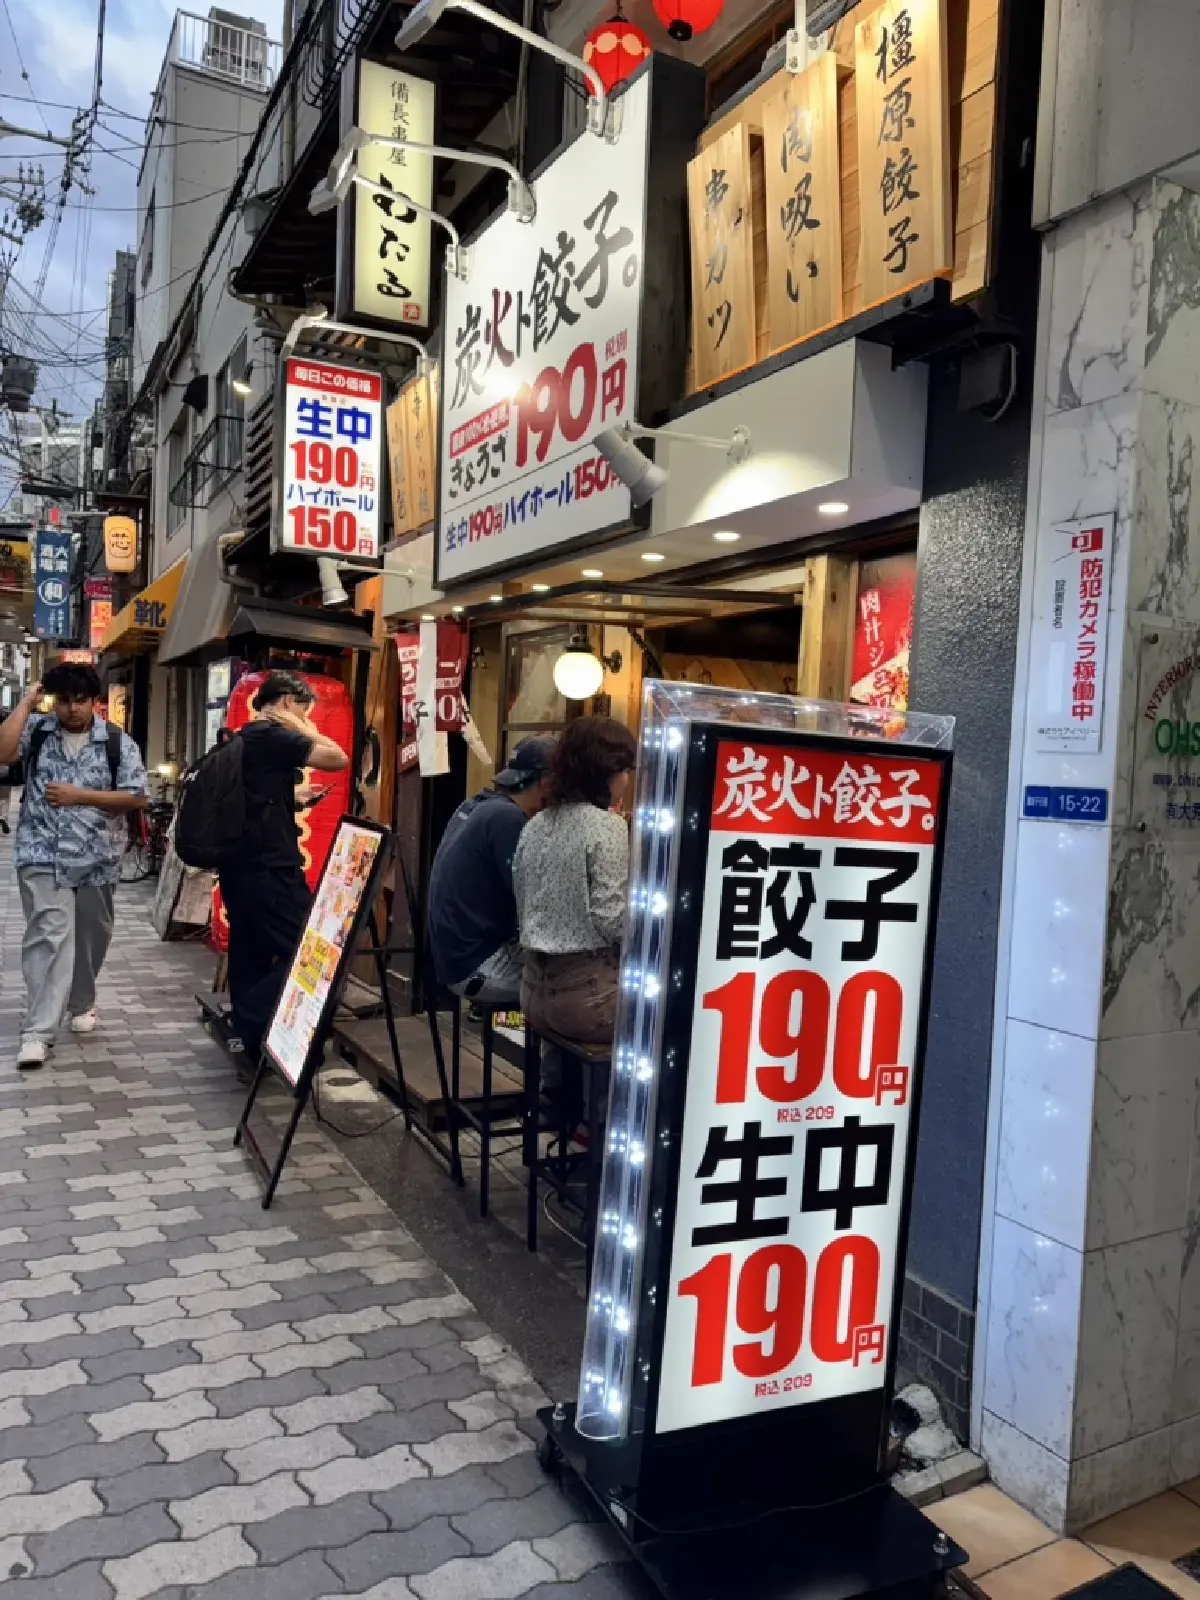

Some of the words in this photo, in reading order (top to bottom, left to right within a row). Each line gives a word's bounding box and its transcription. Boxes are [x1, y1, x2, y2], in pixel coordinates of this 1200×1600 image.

[294, 366, 372, 394] 毎日この価格
[296, 397, 373, 445] 生中
[289, 440, 375, 492] 190円
[286, 483, 374, 511] ハイボール
[287, 505, 374, 556] 150円
[1071, 557, 1104, 721] 防犯カメラ稼働中
[713, 746, 935, 831] 炭火ト餃子。
[1058, 794, 1101, 813] 15-22
[716, 839, 919, 962] 餃子
[805, 1105, 835, 1121] 209
[691, 1115, 895, 1247] 生中
[783, 1372, 813, 1392] 209
